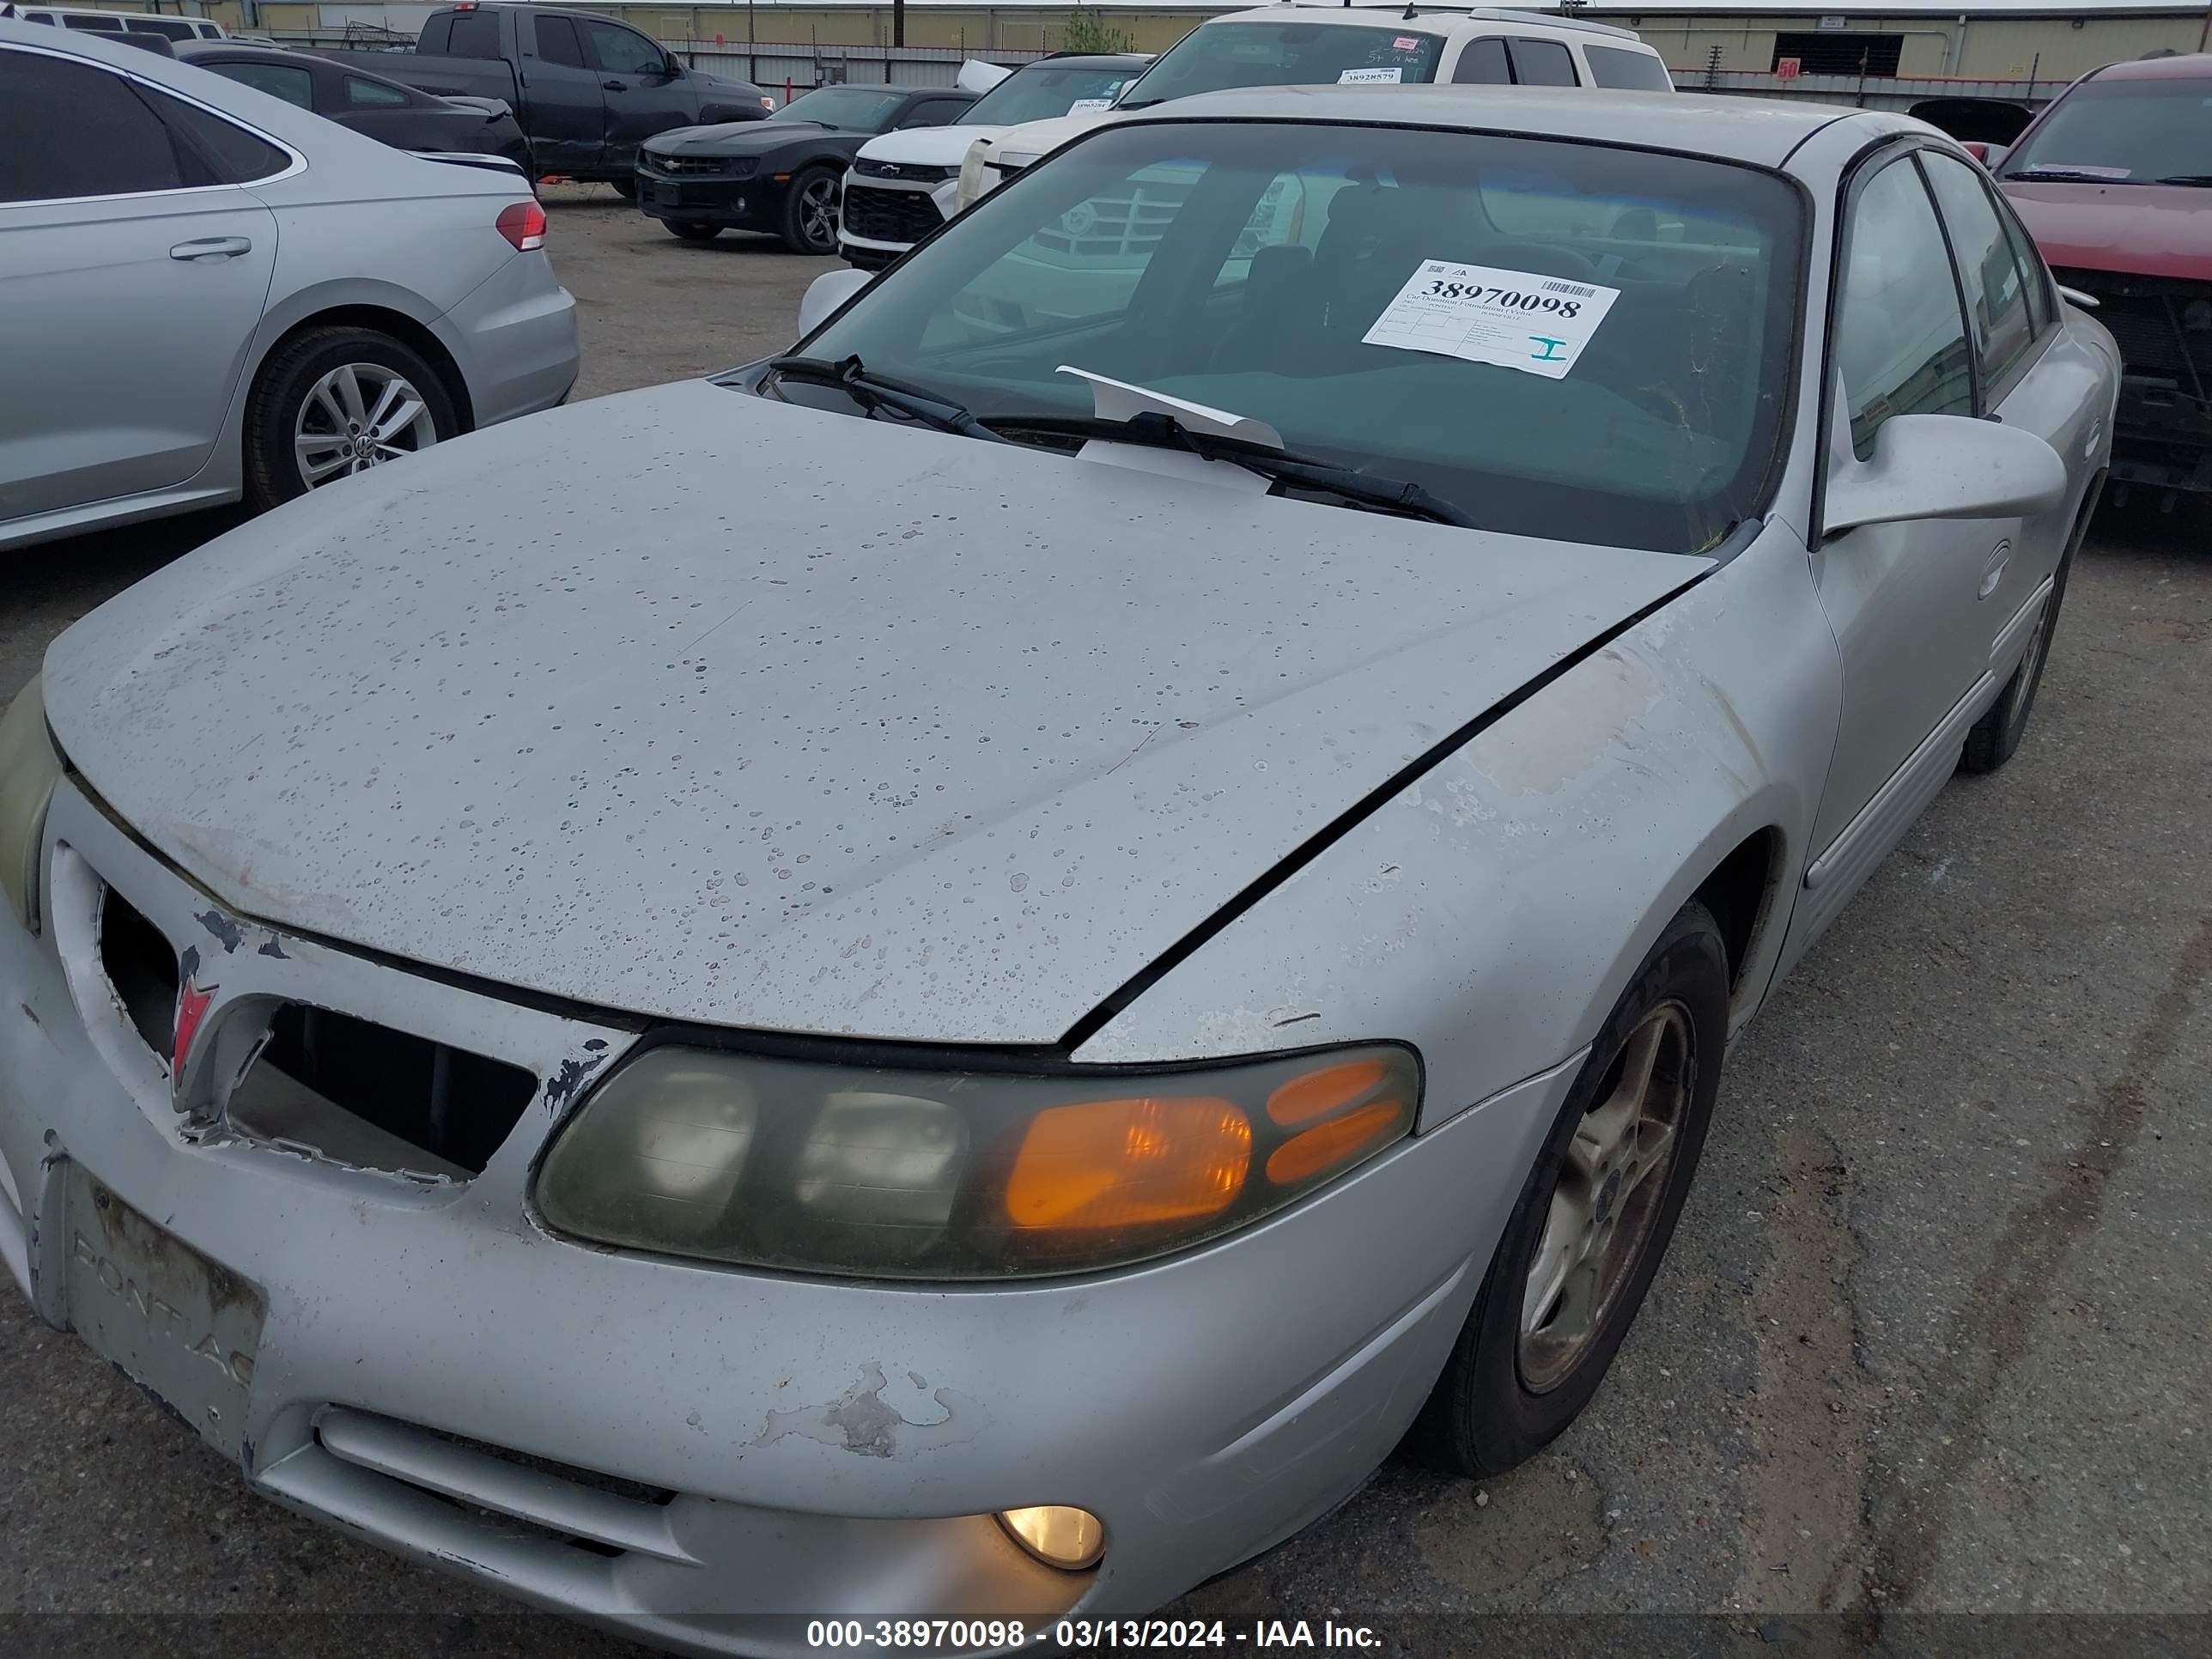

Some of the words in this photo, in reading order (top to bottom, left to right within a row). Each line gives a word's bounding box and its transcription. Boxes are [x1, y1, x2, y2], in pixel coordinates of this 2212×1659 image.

[1346, 73, 1395, 82] 38928579
[1778, 61, 1798, 78] 50
[1421, 295, 1458, 306] Donation
[1460, 301, 1504, 313] Foundation
[1422, 280, 1582, 319] 38970098
